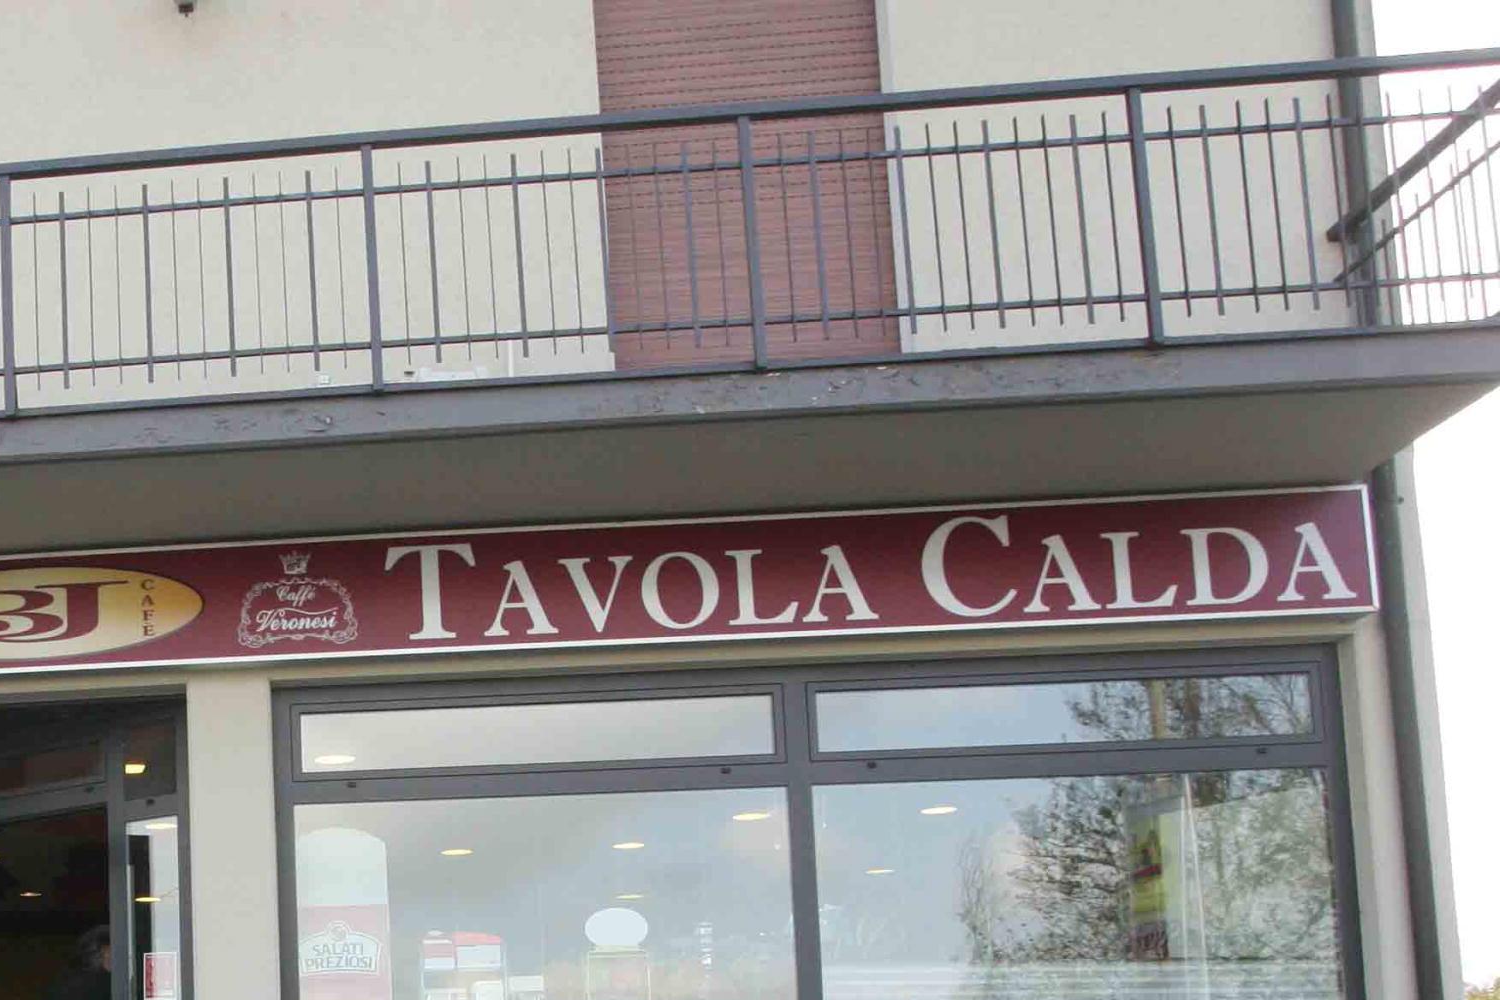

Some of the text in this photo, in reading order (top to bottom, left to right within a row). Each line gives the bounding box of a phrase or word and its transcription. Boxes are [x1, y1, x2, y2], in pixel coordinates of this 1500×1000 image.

[383, 514, 1358, 641] TAVOLA CALDA
[255, 607, 338, 633] Veronesi
[312, 943, 364, 956] SALATI
[306, 956, 373, 970] PREZIOSI
